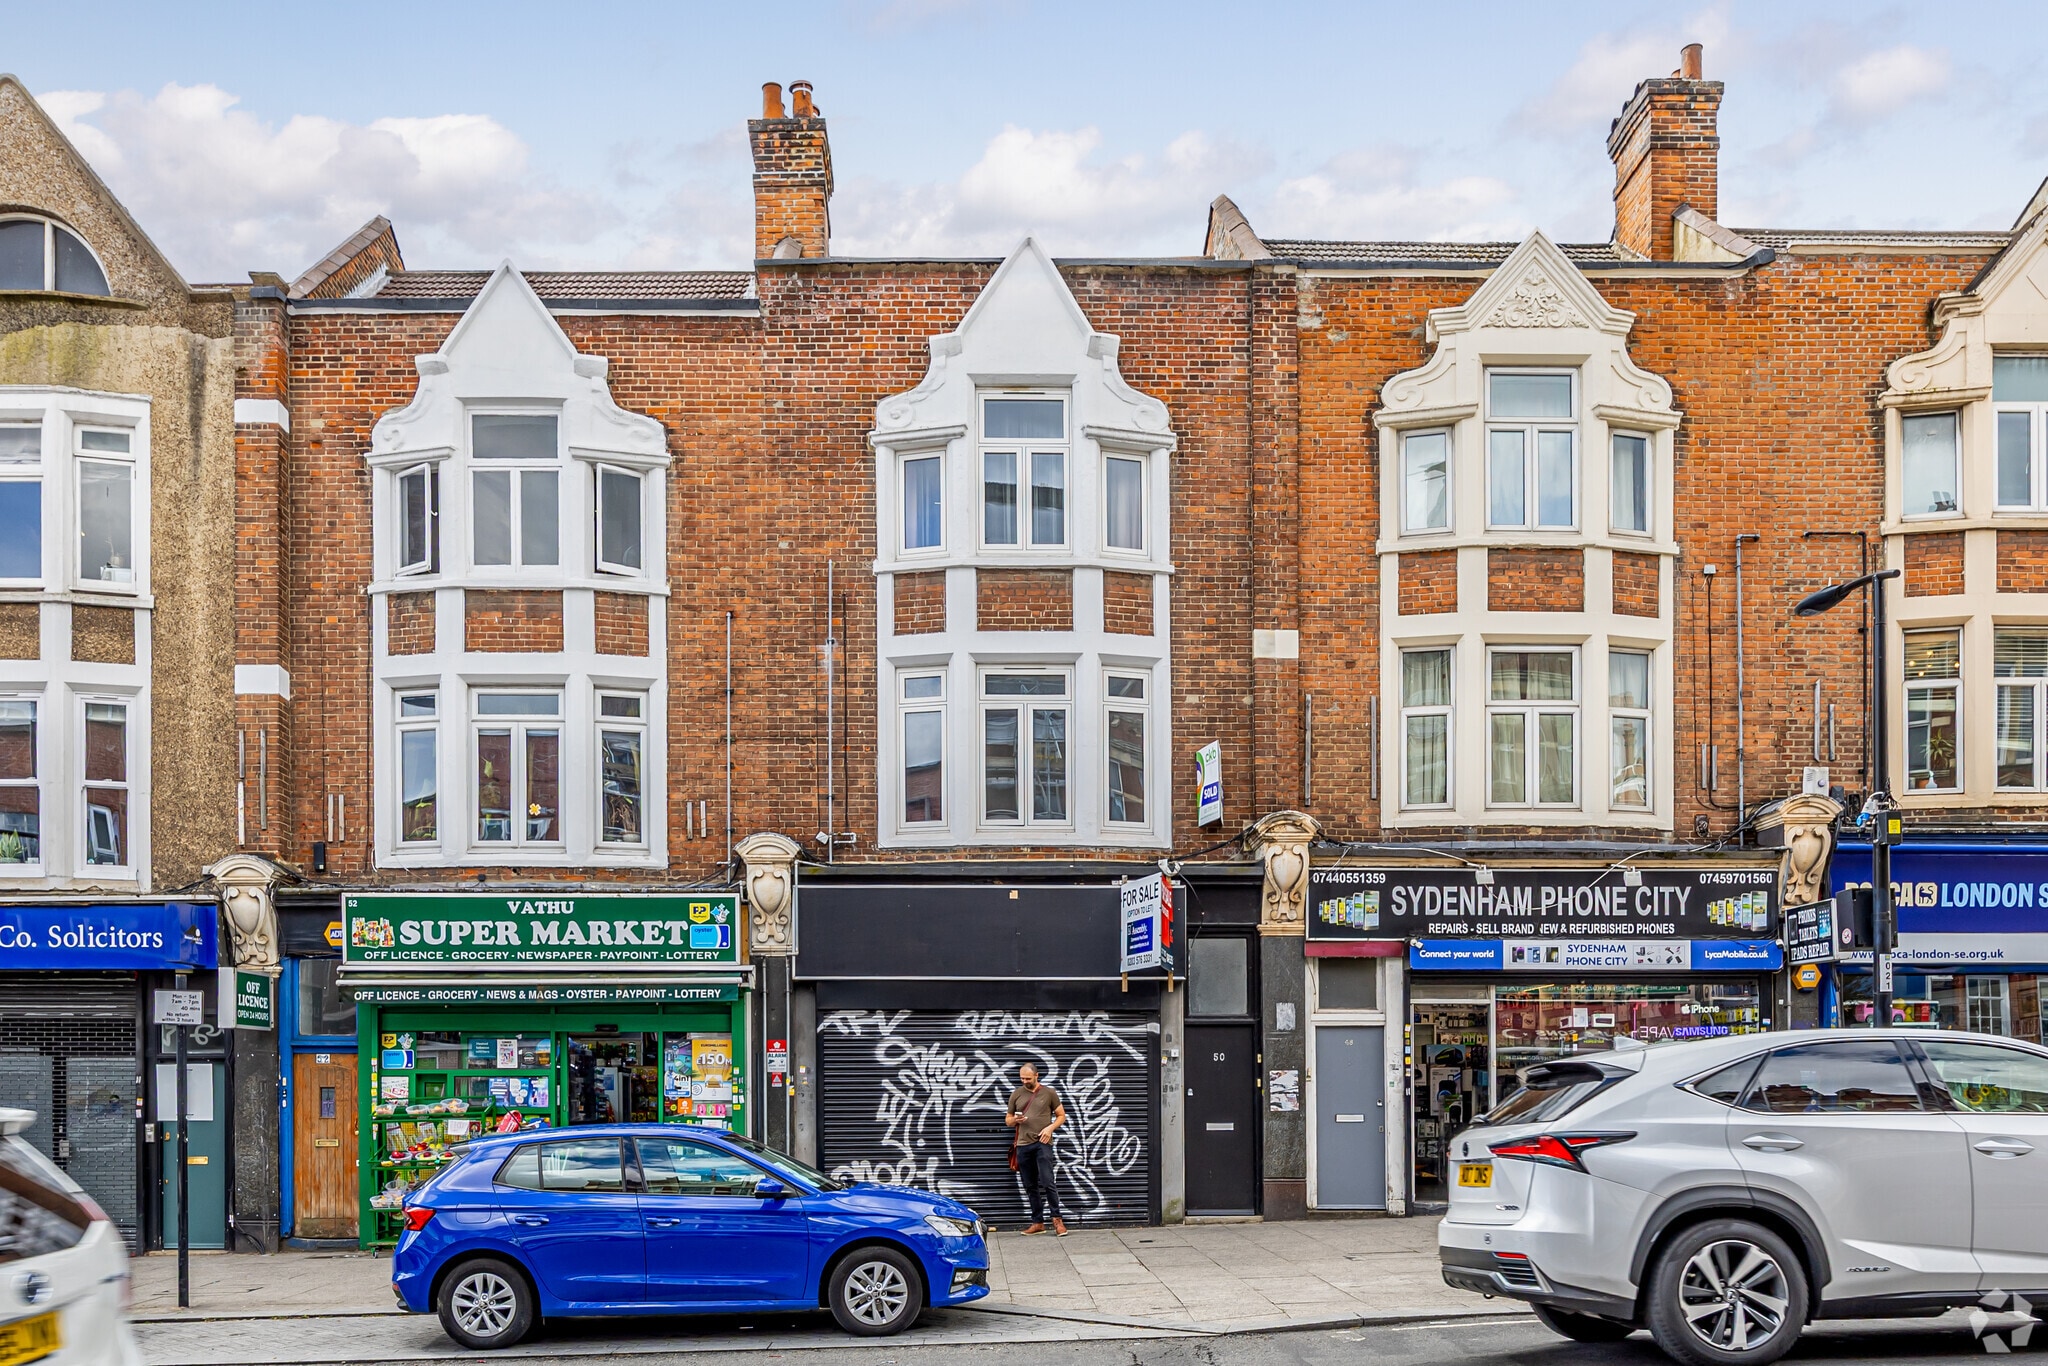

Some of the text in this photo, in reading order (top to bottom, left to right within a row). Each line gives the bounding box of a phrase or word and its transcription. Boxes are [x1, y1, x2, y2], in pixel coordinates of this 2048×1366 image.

[1204, 786, 1218, 800] SOLD
[1313, 872, 1386, 884] 07440551359
[1700, 873, 1772, 884] 07459701560
[1122, 888, 1137, 908] FOR
[1138, 882, 1159, 903] SALE
[1940, 882, 2034, 908] LONDON
[348, 900, 358, 908] 52
[1391, 886, 1692, 916] SYDENHAM PHONE CITY
[506, 901, 574, 914] VATHU
[400, 920, 689, 946] SUPER MARKET
[1428, 923, 1468, 934] REPAIRS
[1476, 923, 1500, 934] SELL
[1502, 923, 1534, 934] BRAND
[1560, 923, 1568, 934] &
[1570, 923, 1634, 934] REFURBISHED
[1636, 923, 1675, 934] PHONES
[0, 924, 163, 948] Co. Solicitors
[1568, 944, 1626, 953] SYDENHAM
[1808, 942, 1830, 958] REPAIR
[364, 952, 388, 960] OFF
[391, 952, 444, 960] LICENCE
[452, 952, 510, 960] GROCERY
[517, 952, 592, 960] NEWSPAPER
[600, 952, 658, 960] PAYPOINT
[666, 952, 720, 960] LOTTERY
[1419, 950, 1494, 960] Connect your world
[1704, 950, 1769, 960] LycaMobile.co.uk
[1566, 956, 1628, 966] PHONE CITY
[246, 981, 260, 994] OFF
[354, 991, 374, 1000] OFF
[377, 991, 420, 1000] LICENCE
[428, 990, 478, 1000] GROCERY
[486, 990, 516, 999] NEWS
[518, 990, 526, 999] &
[528, 990, 558, 999] MAGS
[566, 990, 606, 999] OYSTER
[616, 990, 666, 998] PAYPOINT
[674, 990, 721, 998] LOTTERY
[238, 994, 268, 1009] LICENCE
[238, 1009, 250, 1018] OPEN
[254, 1012, 268, 1020] HOURS
[1692, 1005, 1720, 1014] iPhone
[1675, 1026, 1728, 1036] SAMSUNG
[1214, 1052, 1226, 1062] 50
